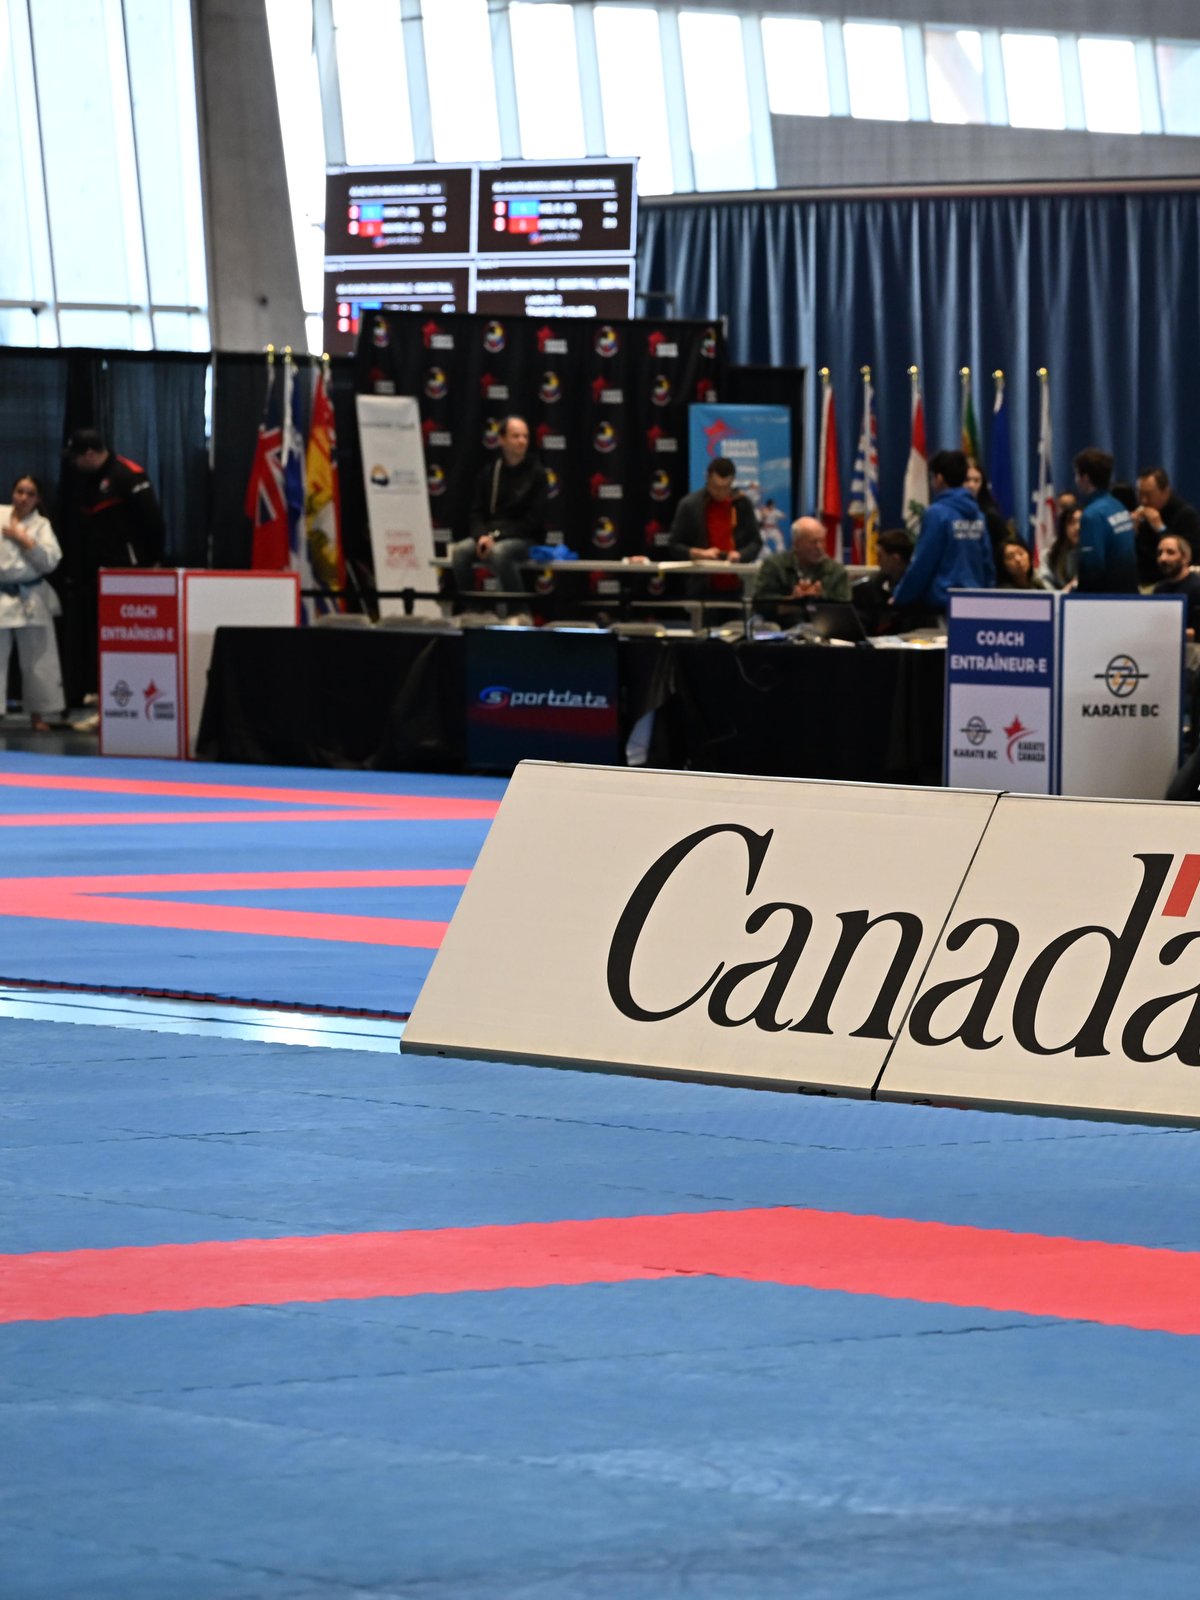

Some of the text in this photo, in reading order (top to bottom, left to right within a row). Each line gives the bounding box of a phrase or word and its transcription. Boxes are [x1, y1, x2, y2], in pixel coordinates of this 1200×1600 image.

[120, 604, 158, 618] COACH
[976, 630, 1024, 647] COACH
[1081, 704, 1159, 717] KARATE BC
[953, 748, 998, 760] KARATE BC
